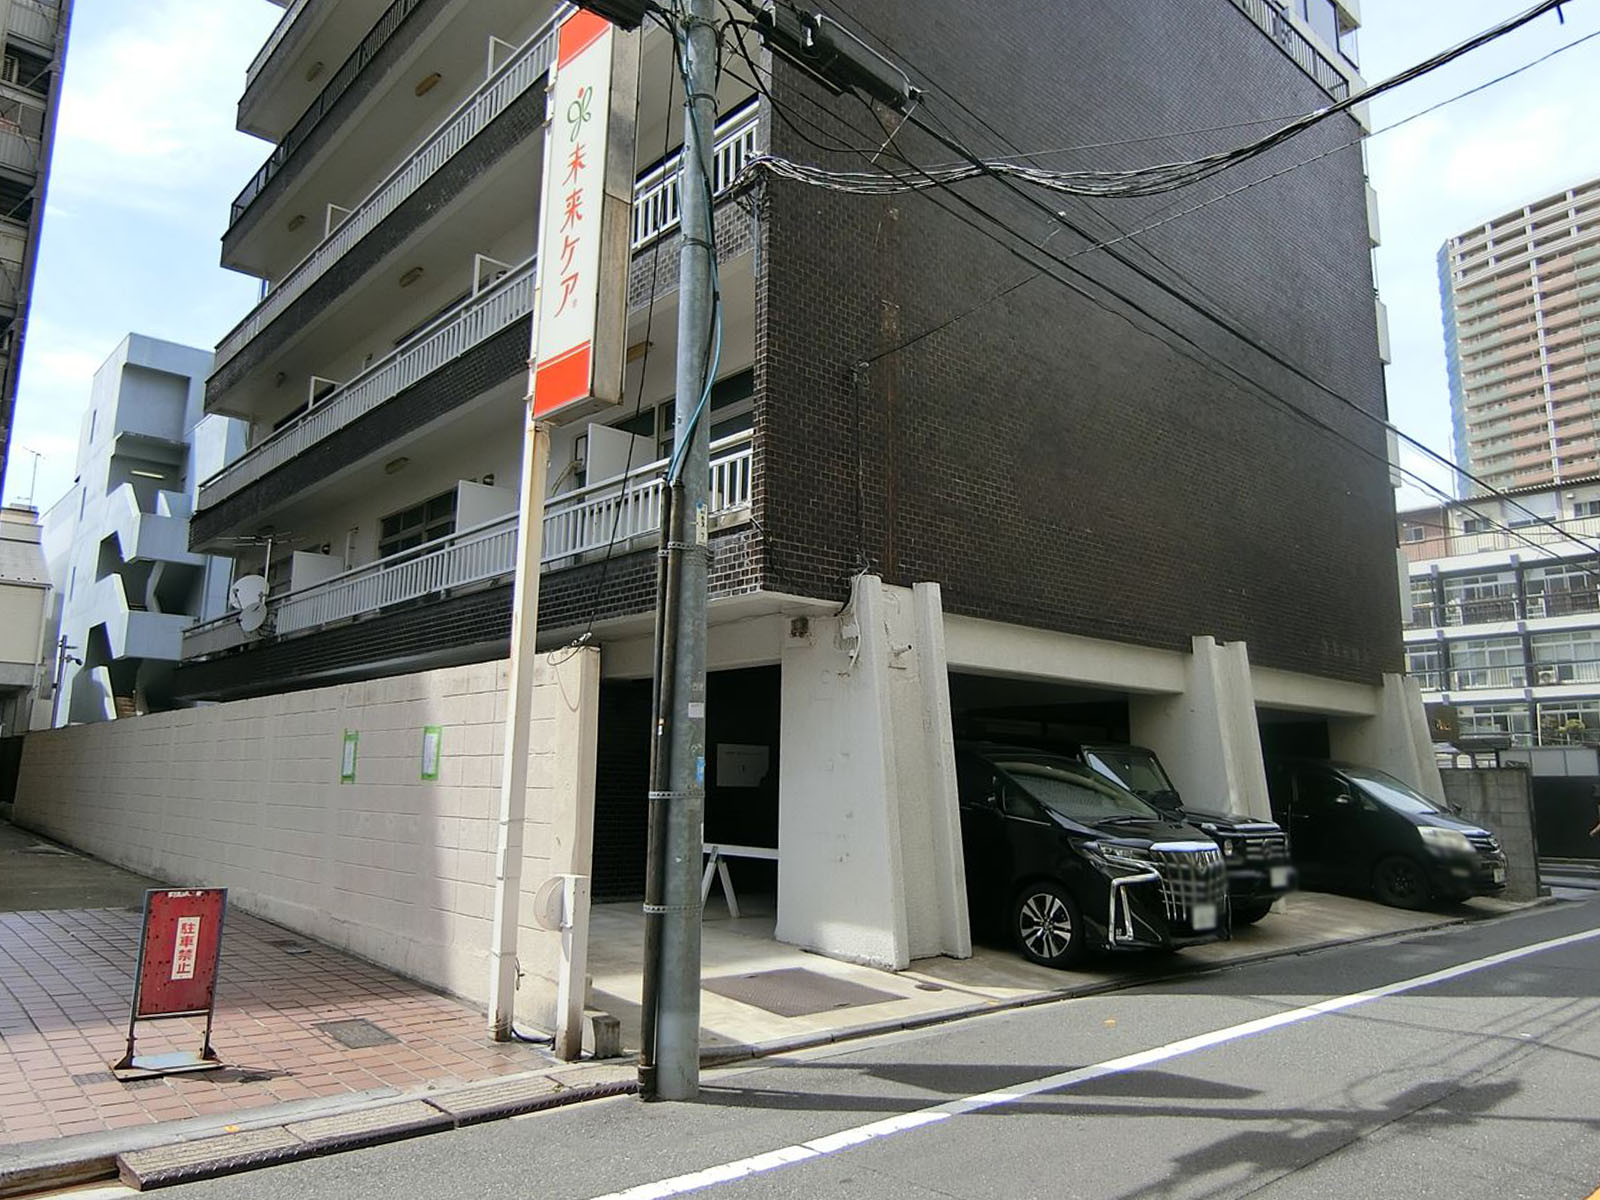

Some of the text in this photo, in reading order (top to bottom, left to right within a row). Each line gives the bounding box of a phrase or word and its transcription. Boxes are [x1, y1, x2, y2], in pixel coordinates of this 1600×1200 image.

[554, 142, 586, 318] 未来ケア
[176, 922, 196, 975] 駐車禁止
